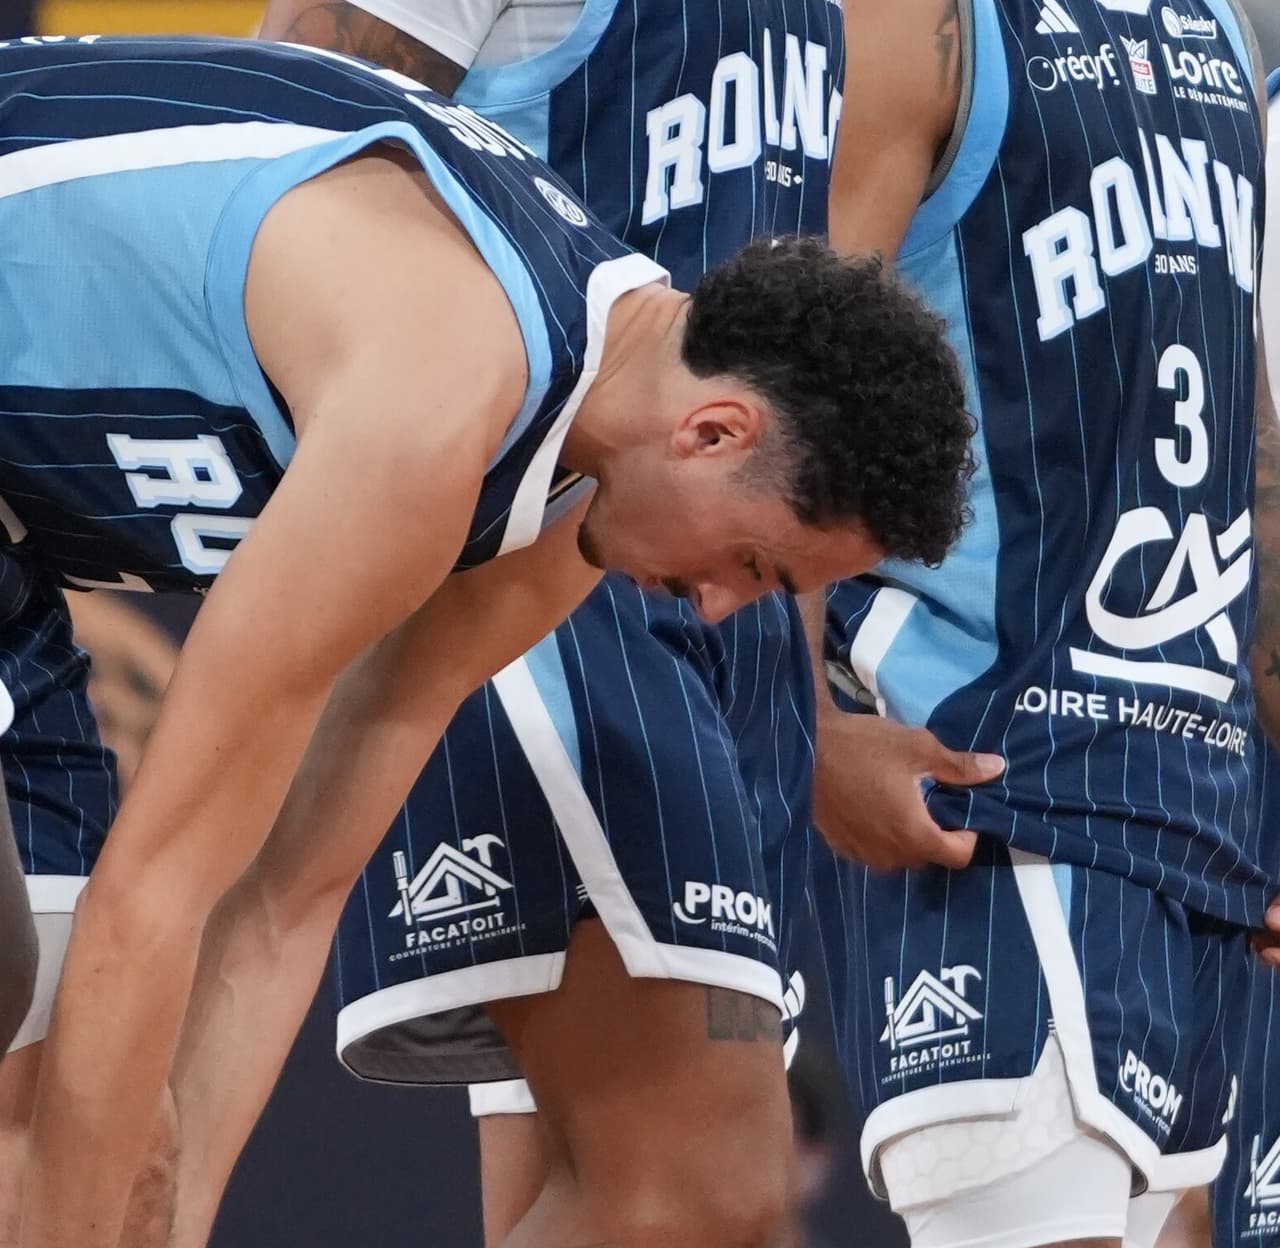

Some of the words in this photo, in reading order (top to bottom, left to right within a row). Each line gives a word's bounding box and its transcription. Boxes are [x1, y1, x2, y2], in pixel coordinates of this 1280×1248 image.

[1161, 43, 1243, 94] Loire
[1169, 254, 1196, 275] ANS
[1155, 344, 1209, 488] 3
[1118, 696, 1247, 757] HAUTE-LOIRE
[405, 911, 506, 948] FACATOIT
[889, 1040, 972, 1072] FACATOIT
